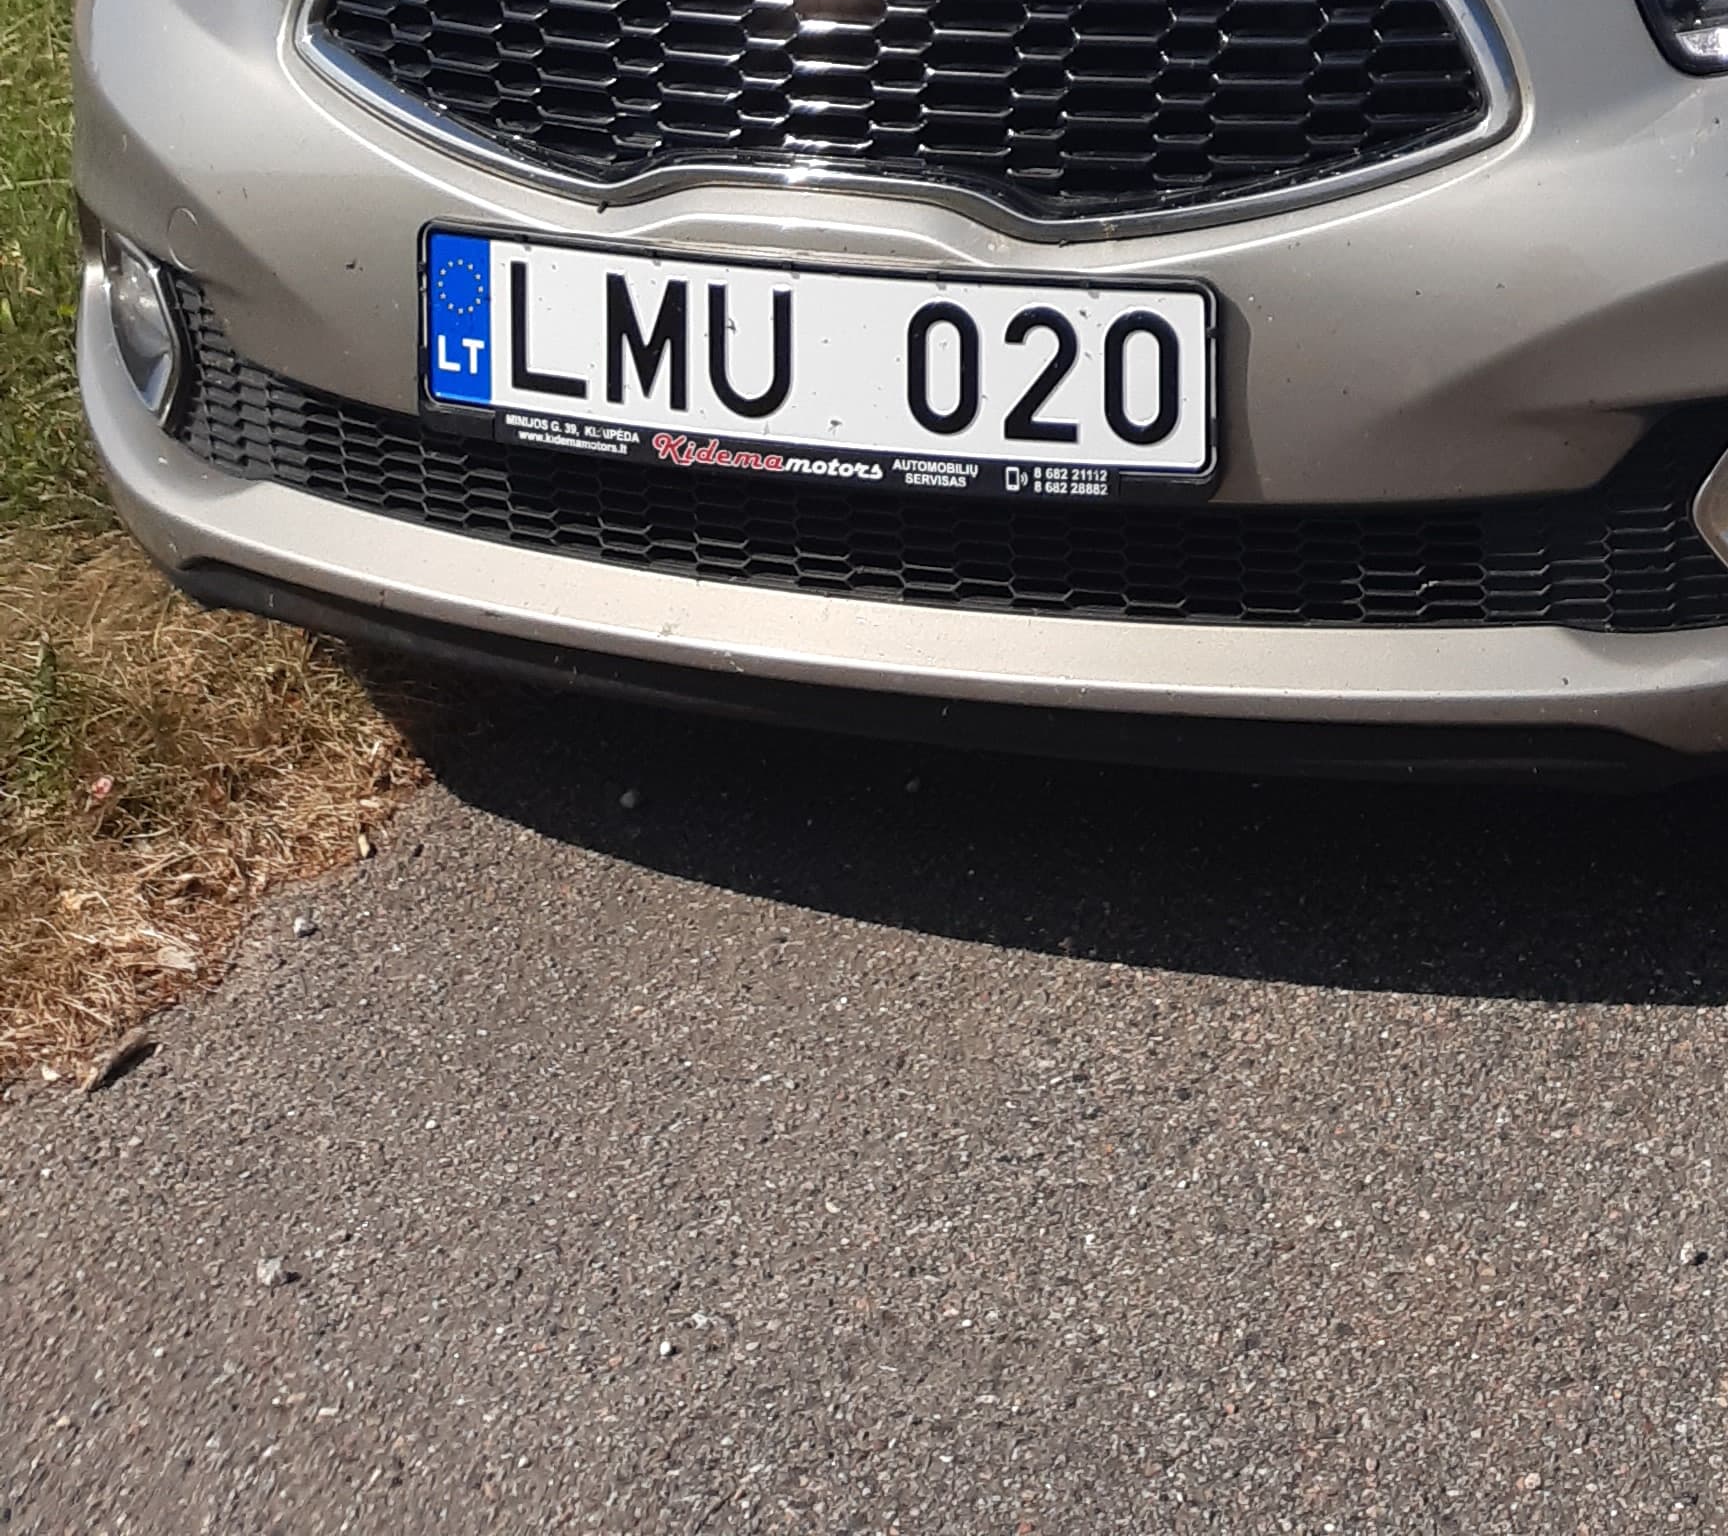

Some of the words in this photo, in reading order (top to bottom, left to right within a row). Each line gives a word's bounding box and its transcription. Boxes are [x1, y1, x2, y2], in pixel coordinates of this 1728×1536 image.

[436, 335, 487, 377] LT
[508, 261, 793, 420] LMU
[905, 300, 1181, 447] 020
[550, 420, 563, 433] G.
[517, 430, 628, 455] www.kidemamotors.lt
[892, 459, 979, 478] AUTOMOBILIŲ
[1033, 466, 1042, 479] 8
[1045, 467, 1069, 480] 682
[905, 472, 967, 487] SERVISAS
[1033, 480, 1043, 493] 8
[1045, 481, 1068, 494] 682
